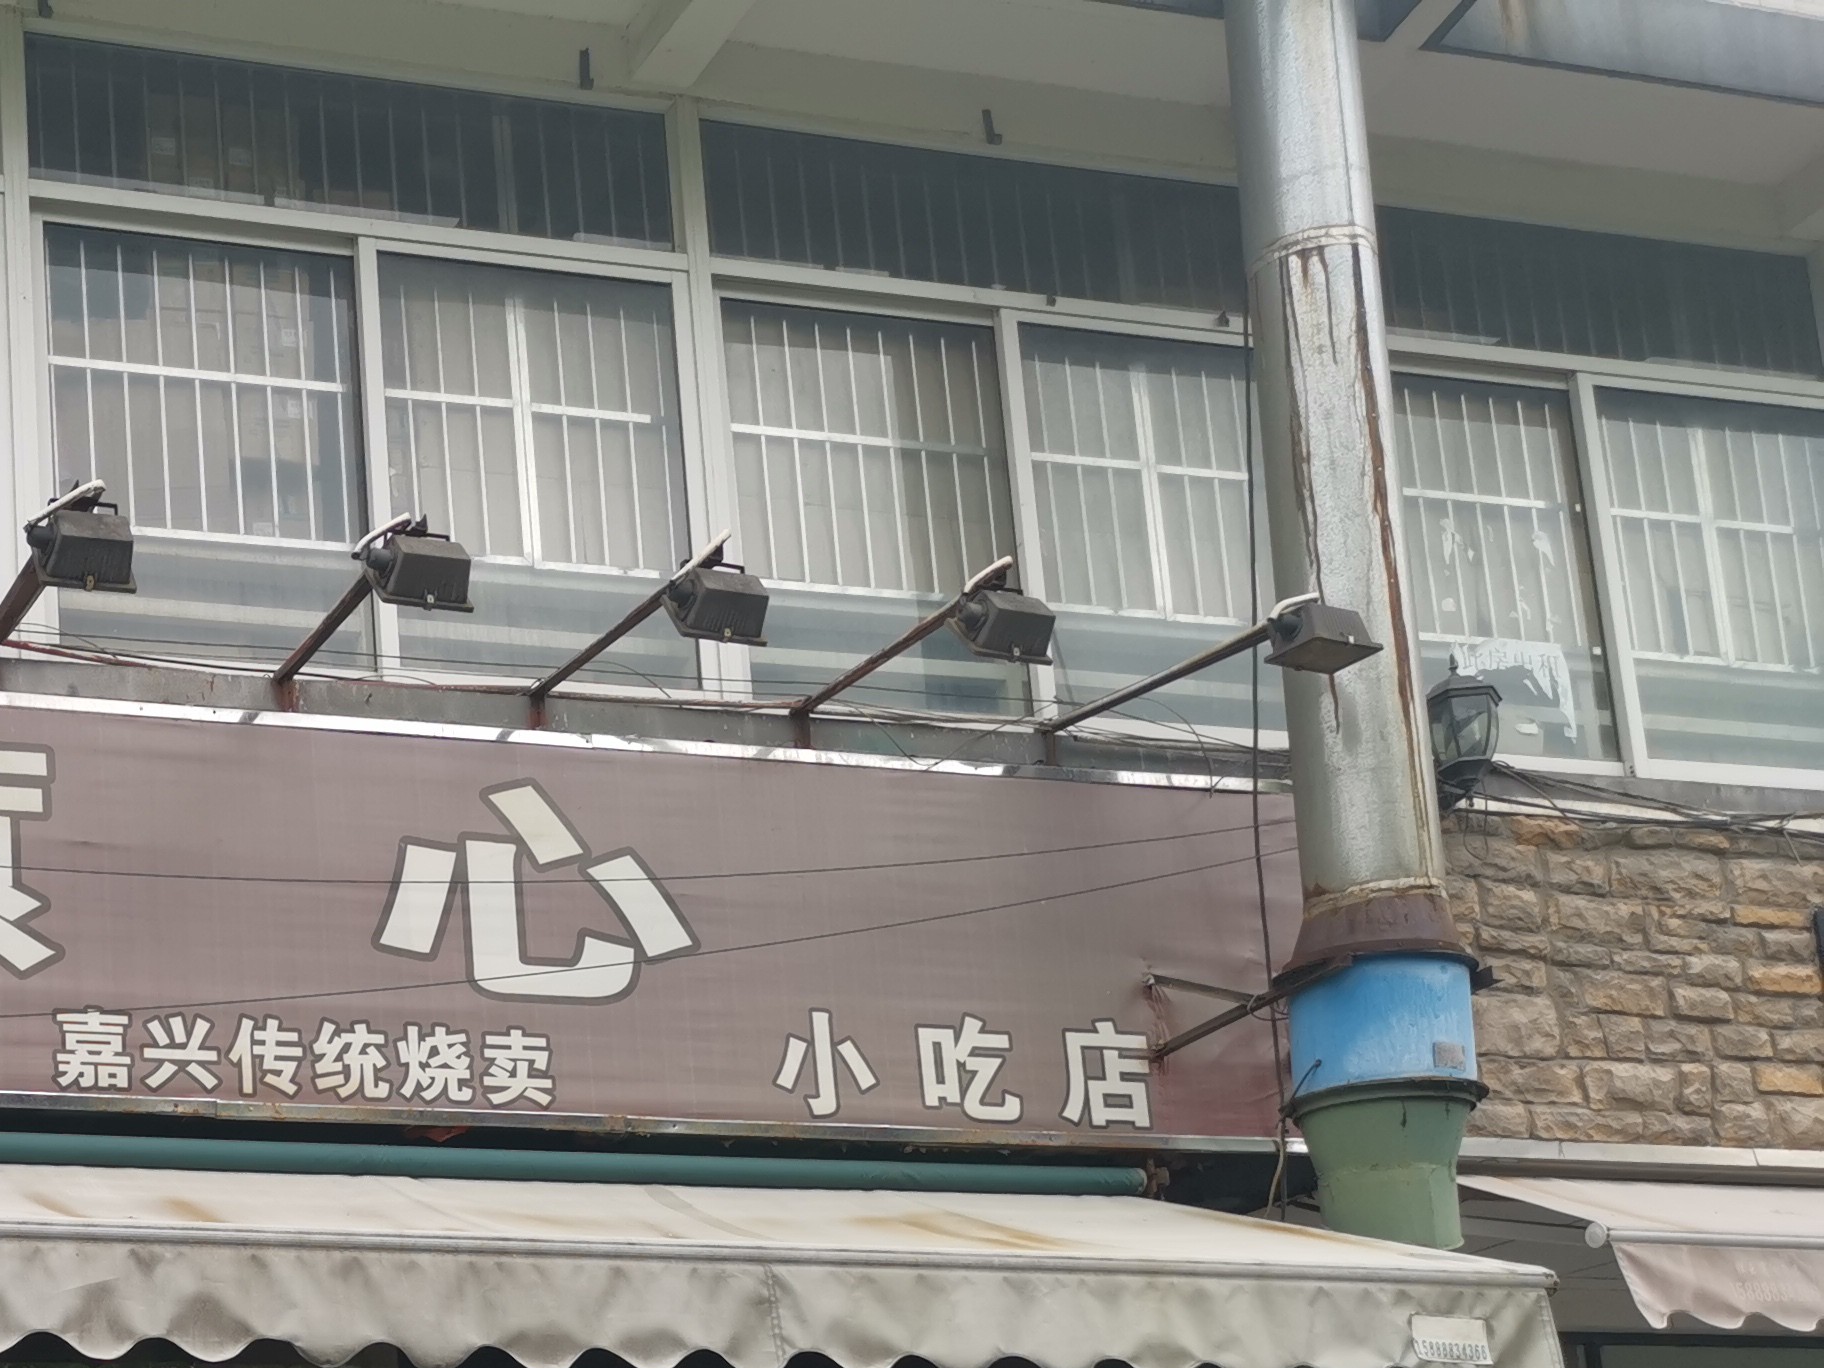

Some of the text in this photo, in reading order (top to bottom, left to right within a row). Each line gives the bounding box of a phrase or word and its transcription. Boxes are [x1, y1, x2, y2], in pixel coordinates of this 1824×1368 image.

[53, 1007, 558, 1108] 嘉兴传统烧卖
[774, 1009, 1156, 1130] 小吃店
